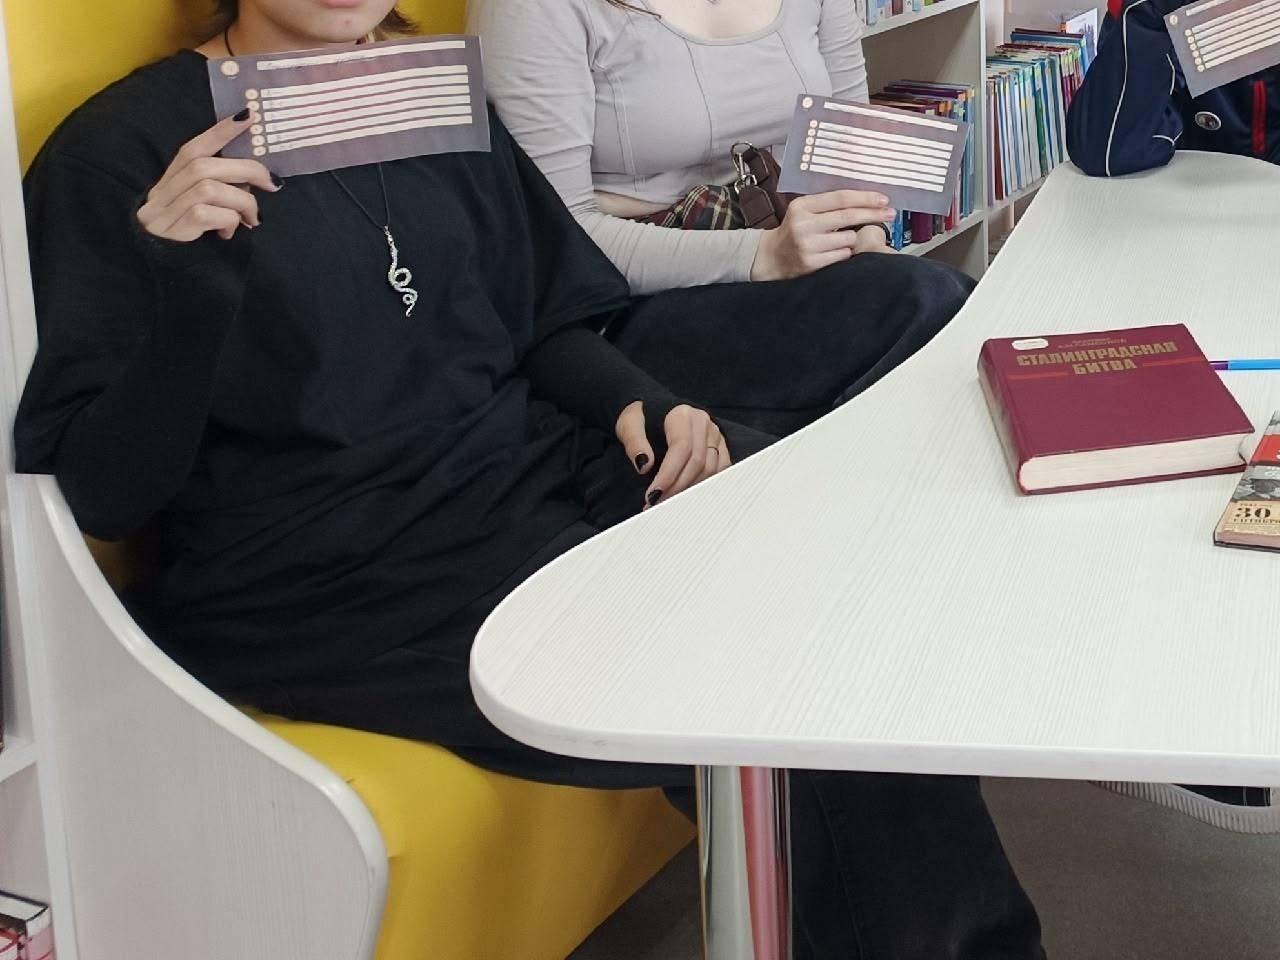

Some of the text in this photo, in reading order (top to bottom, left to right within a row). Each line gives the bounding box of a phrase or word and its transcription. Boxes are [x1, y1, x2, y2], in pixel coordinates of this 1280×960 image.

[1016, 341, 1179, 366] СТАЛИНГРАДСКАЯ
[1071, 359, 1138, 375] БИТВА
[1235, 506, 1271, 518] 30
